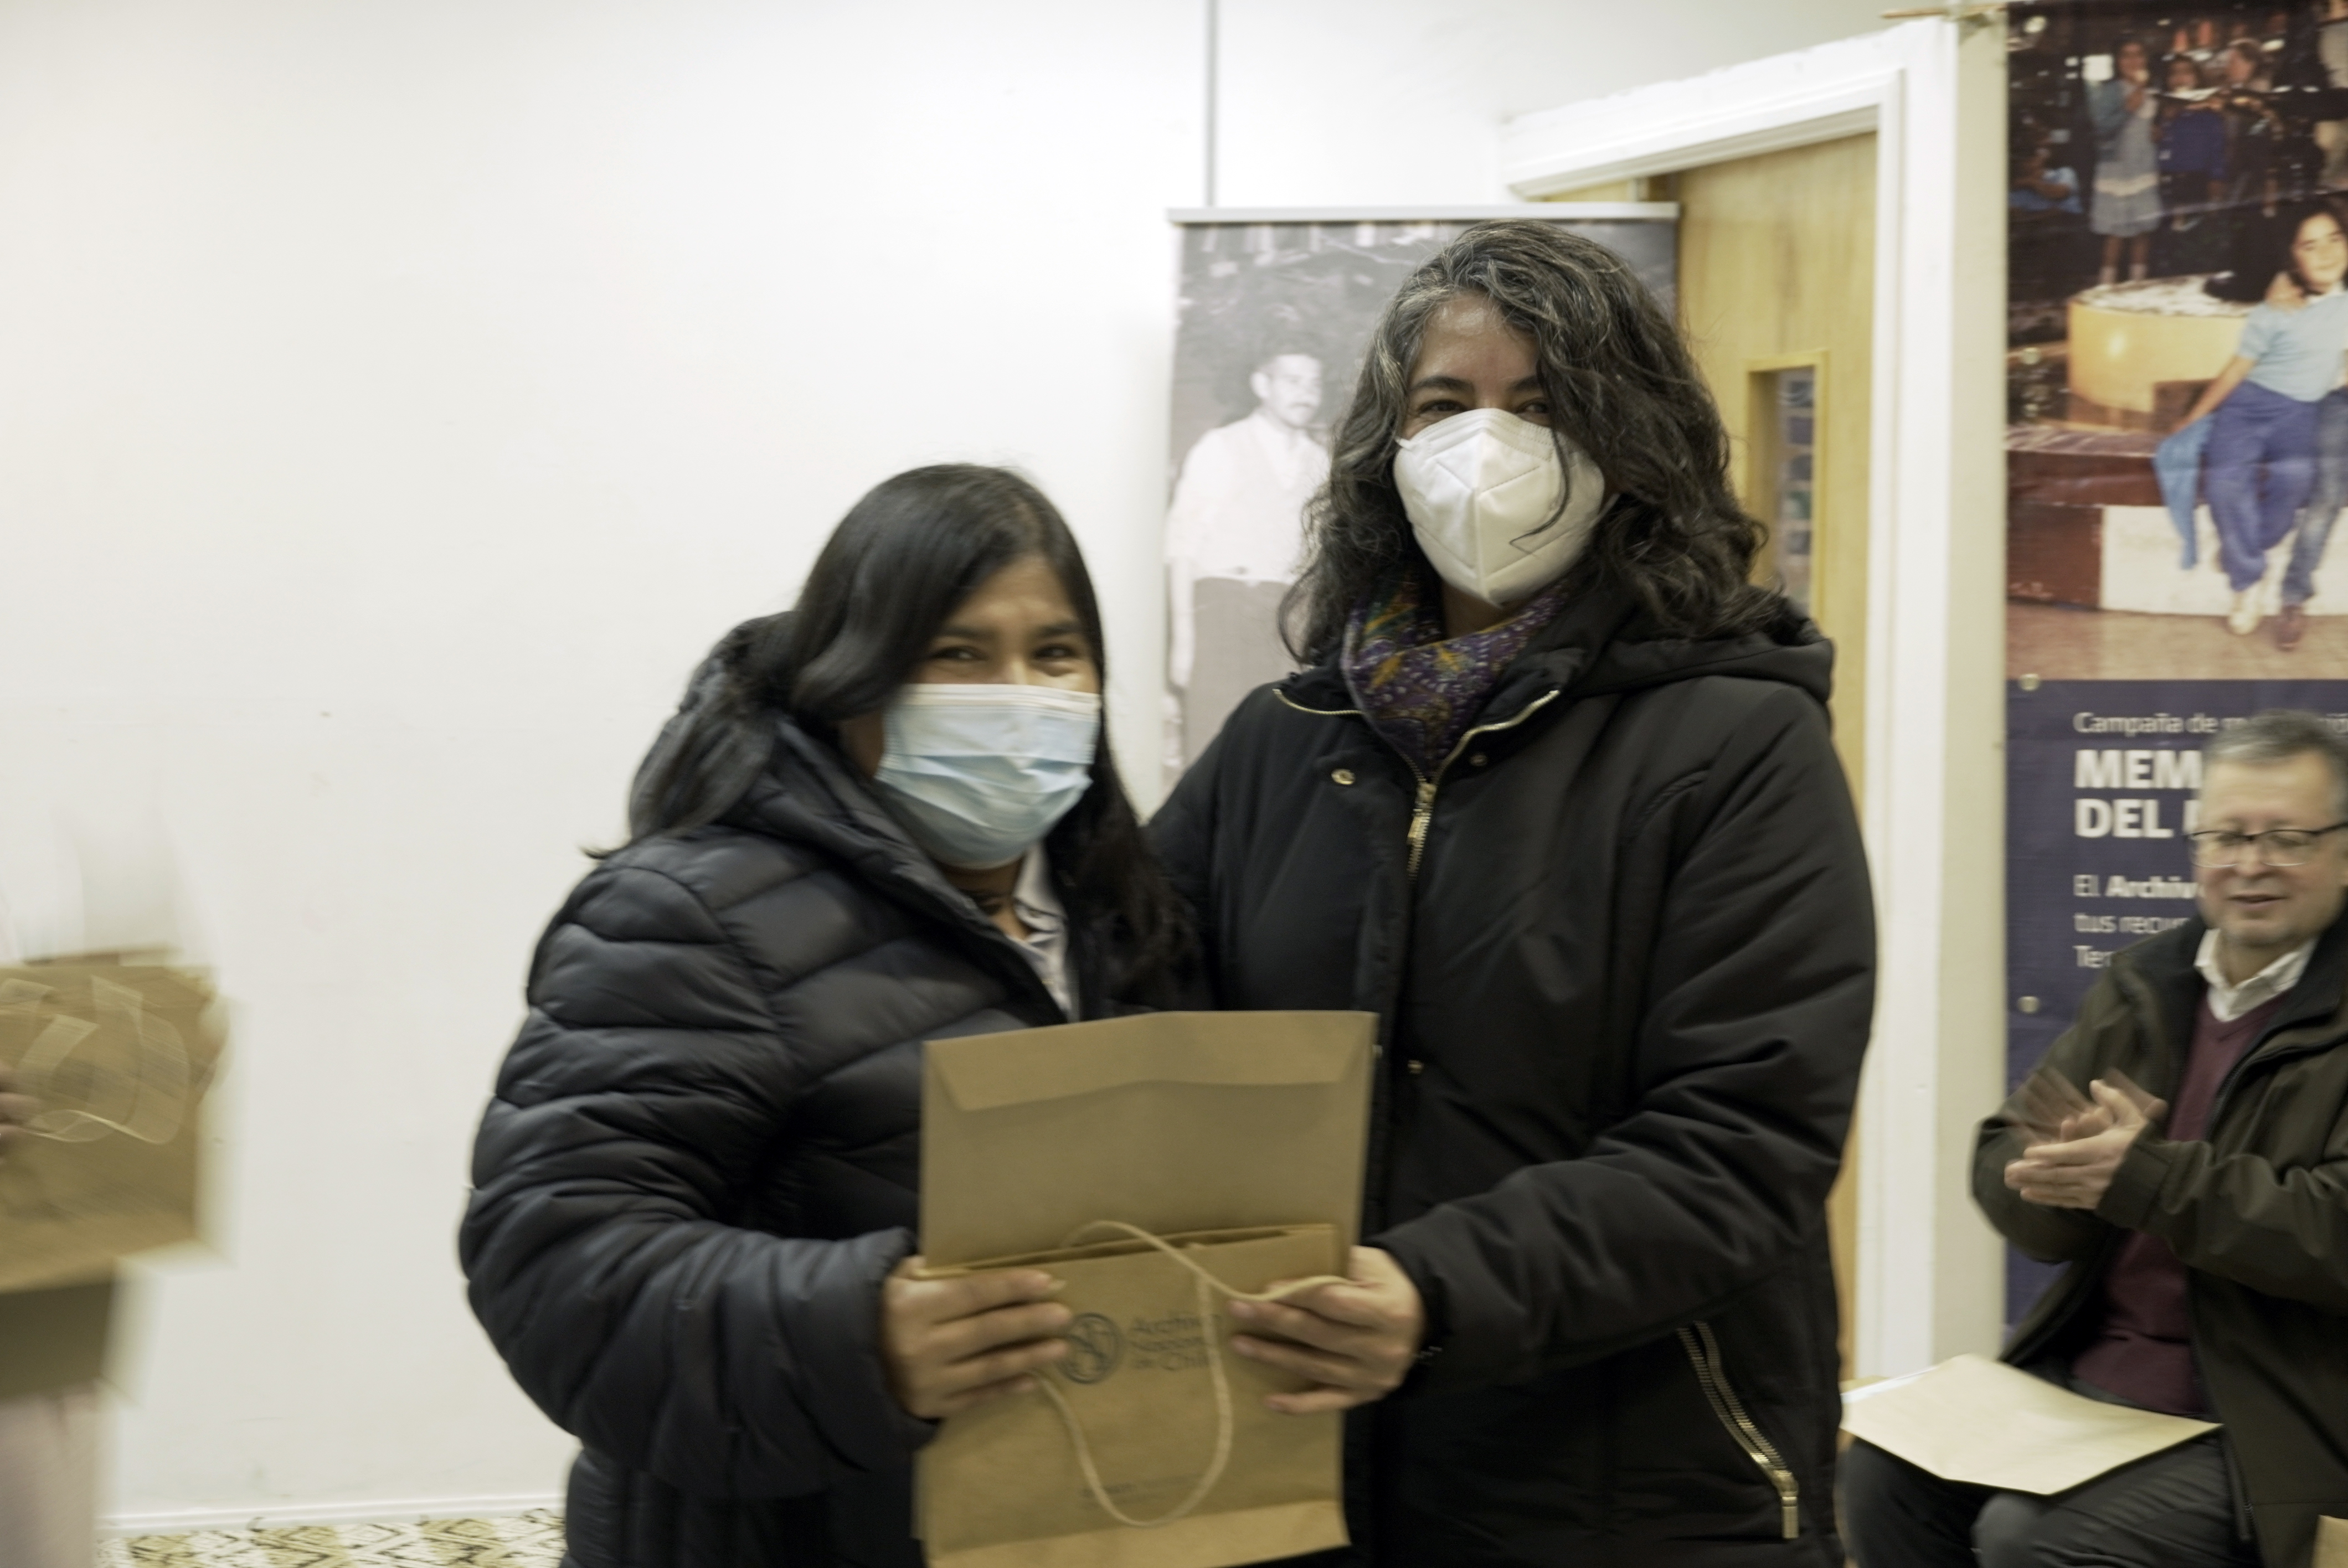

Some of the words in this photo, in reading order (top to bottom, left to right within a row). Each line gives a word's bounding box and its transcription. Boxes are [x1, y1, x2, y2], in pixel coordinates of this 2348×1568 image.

[2073, 711, 2184, 737] Campaña
[2186, 713, 2218, 734] de
[2075, 750, 2203, 788] MEM
[2074, 798, 2174, 838] DEL
[2073, 874, 2100, 898] El
[2105, 875, 2204, 899] Archiv
[2074, 913, 2117, 933] tus
